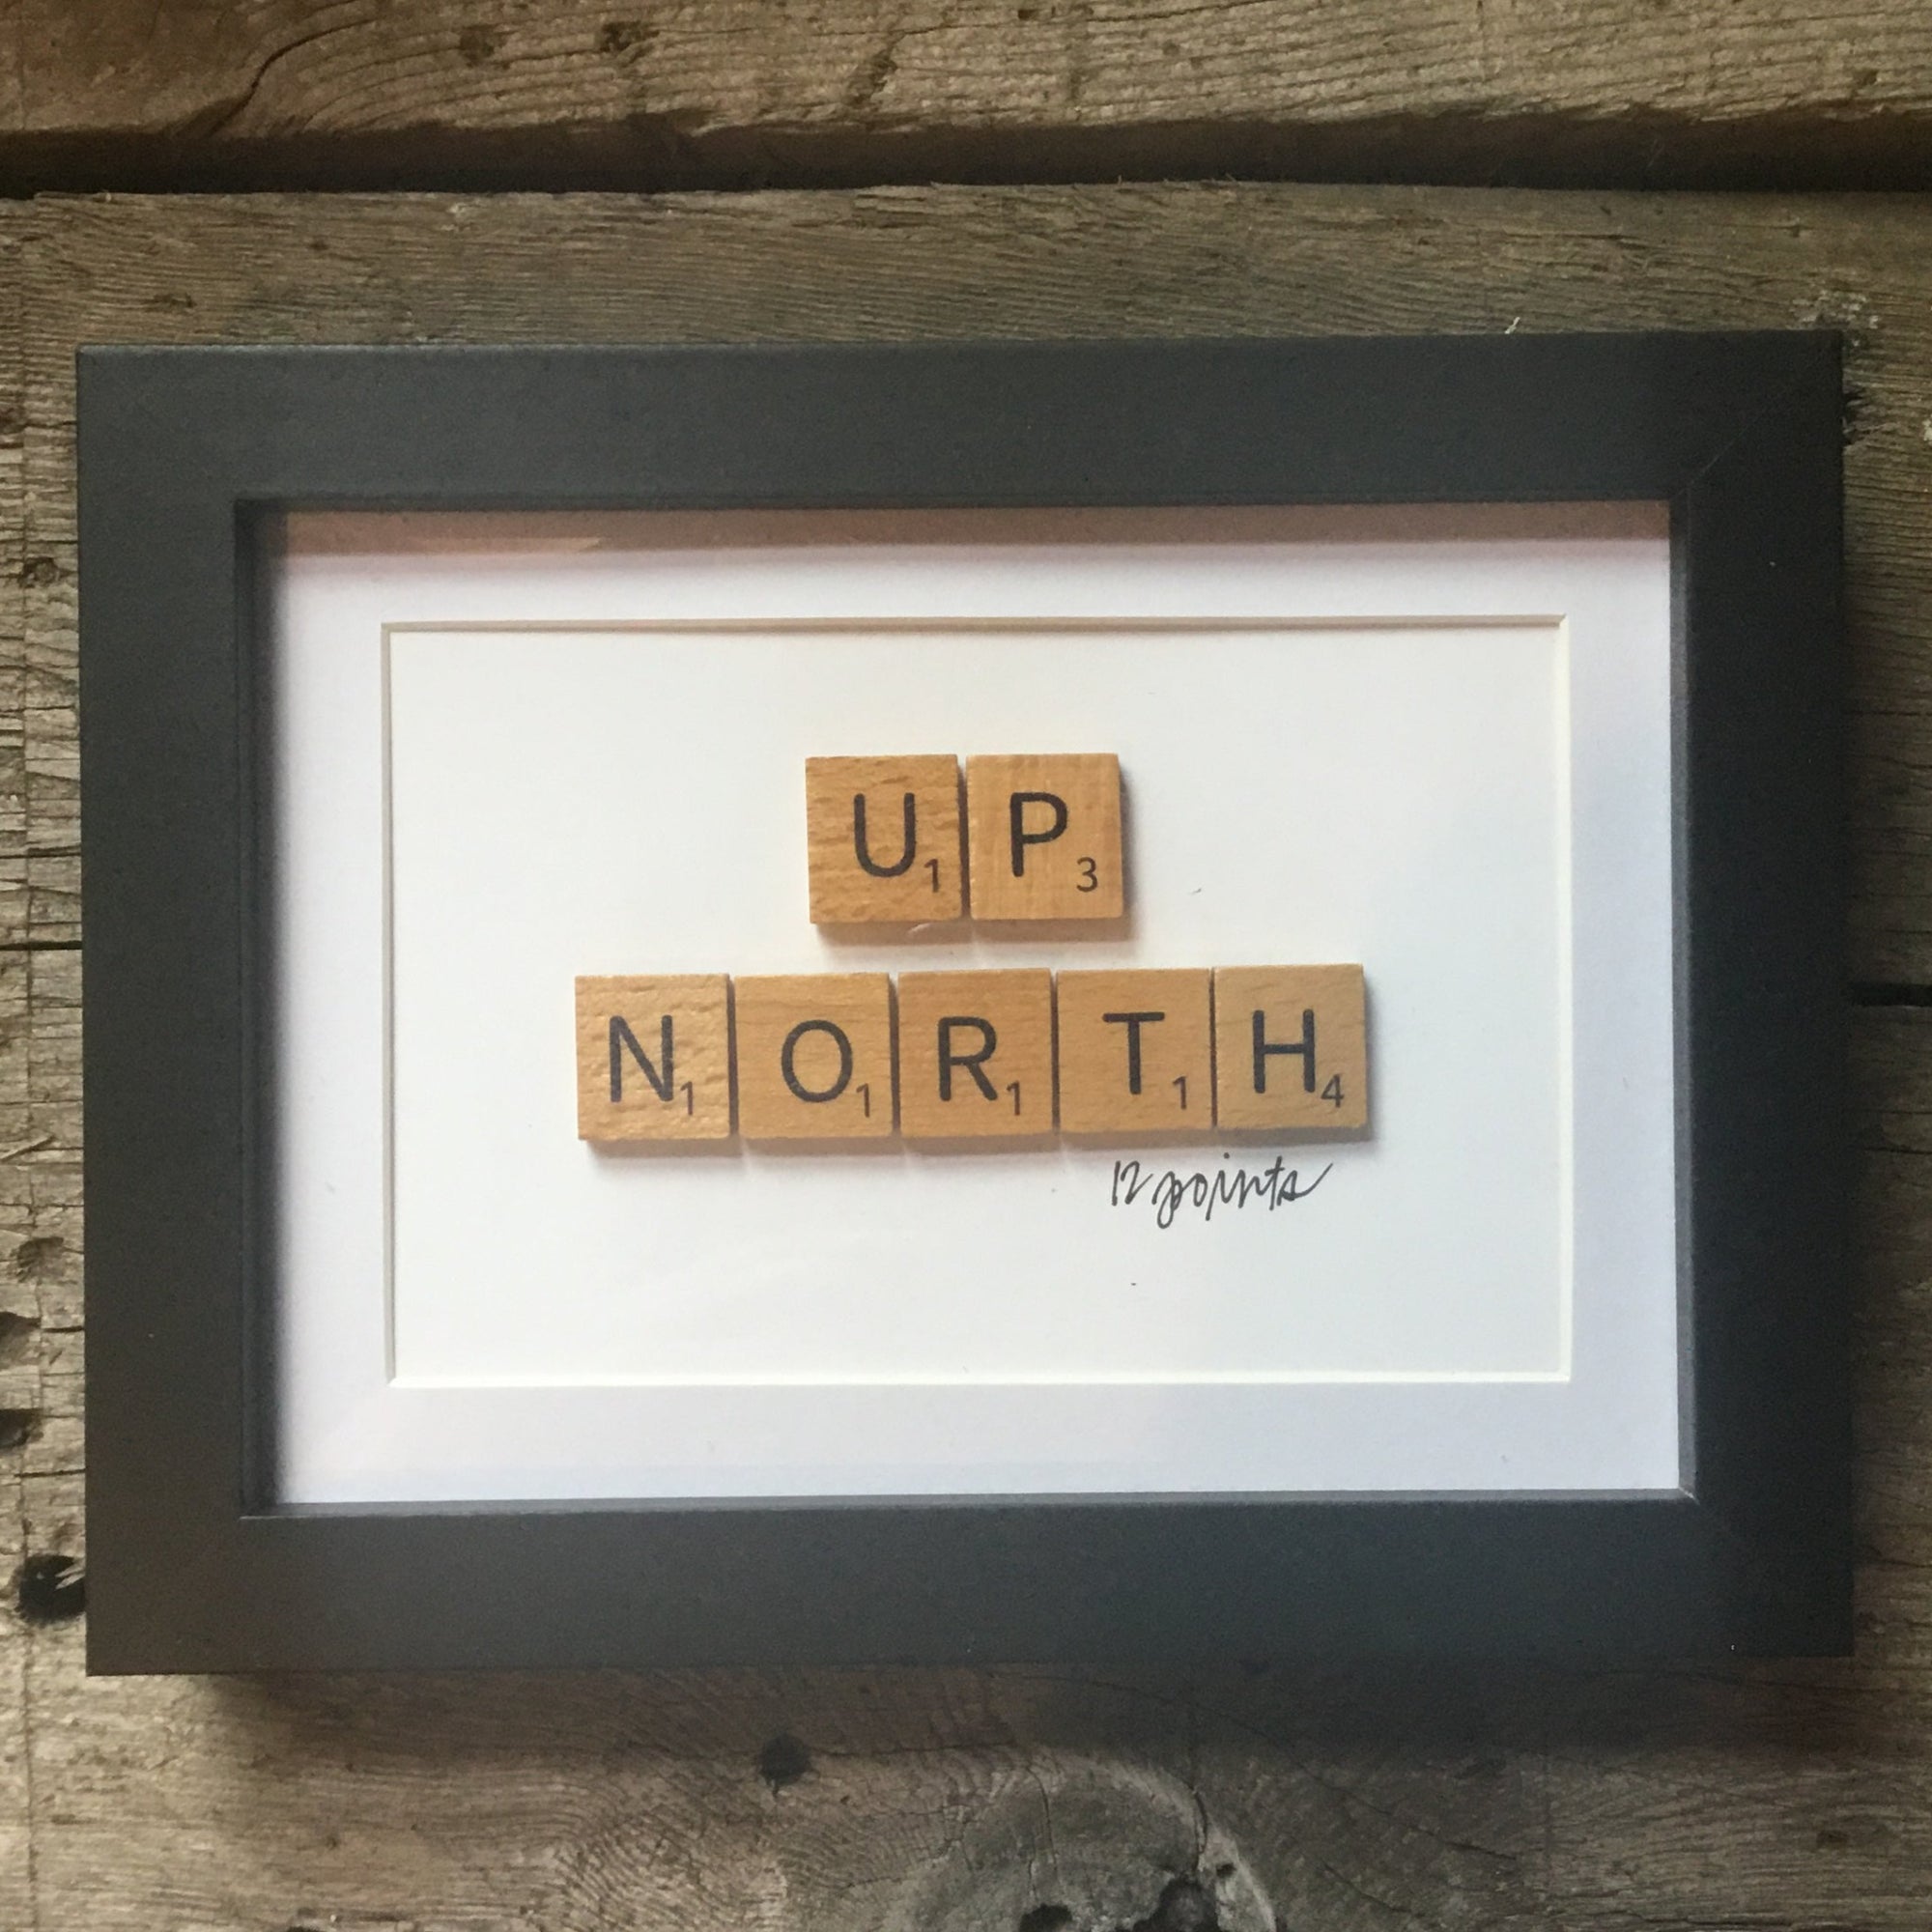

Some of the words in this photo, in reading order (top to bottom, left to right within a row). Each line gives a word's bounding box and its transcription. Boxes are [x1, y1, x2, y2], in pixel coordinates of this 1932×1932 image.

[923, 858, 941, 894] 1
[1075, 857, 1098, 893] 3
[679, 1081, 695, 1116] 1
[855, 1084, 871, 1118] 1
[1006, 1081, 1021, 1116] 1
[1172, 1076, 1187, 1110] 1
[1320, 1073, 1345, 1108] 4
[1111, 1160, 1153, 1206] 12
[1151, 1152, 1333, 1229] points
